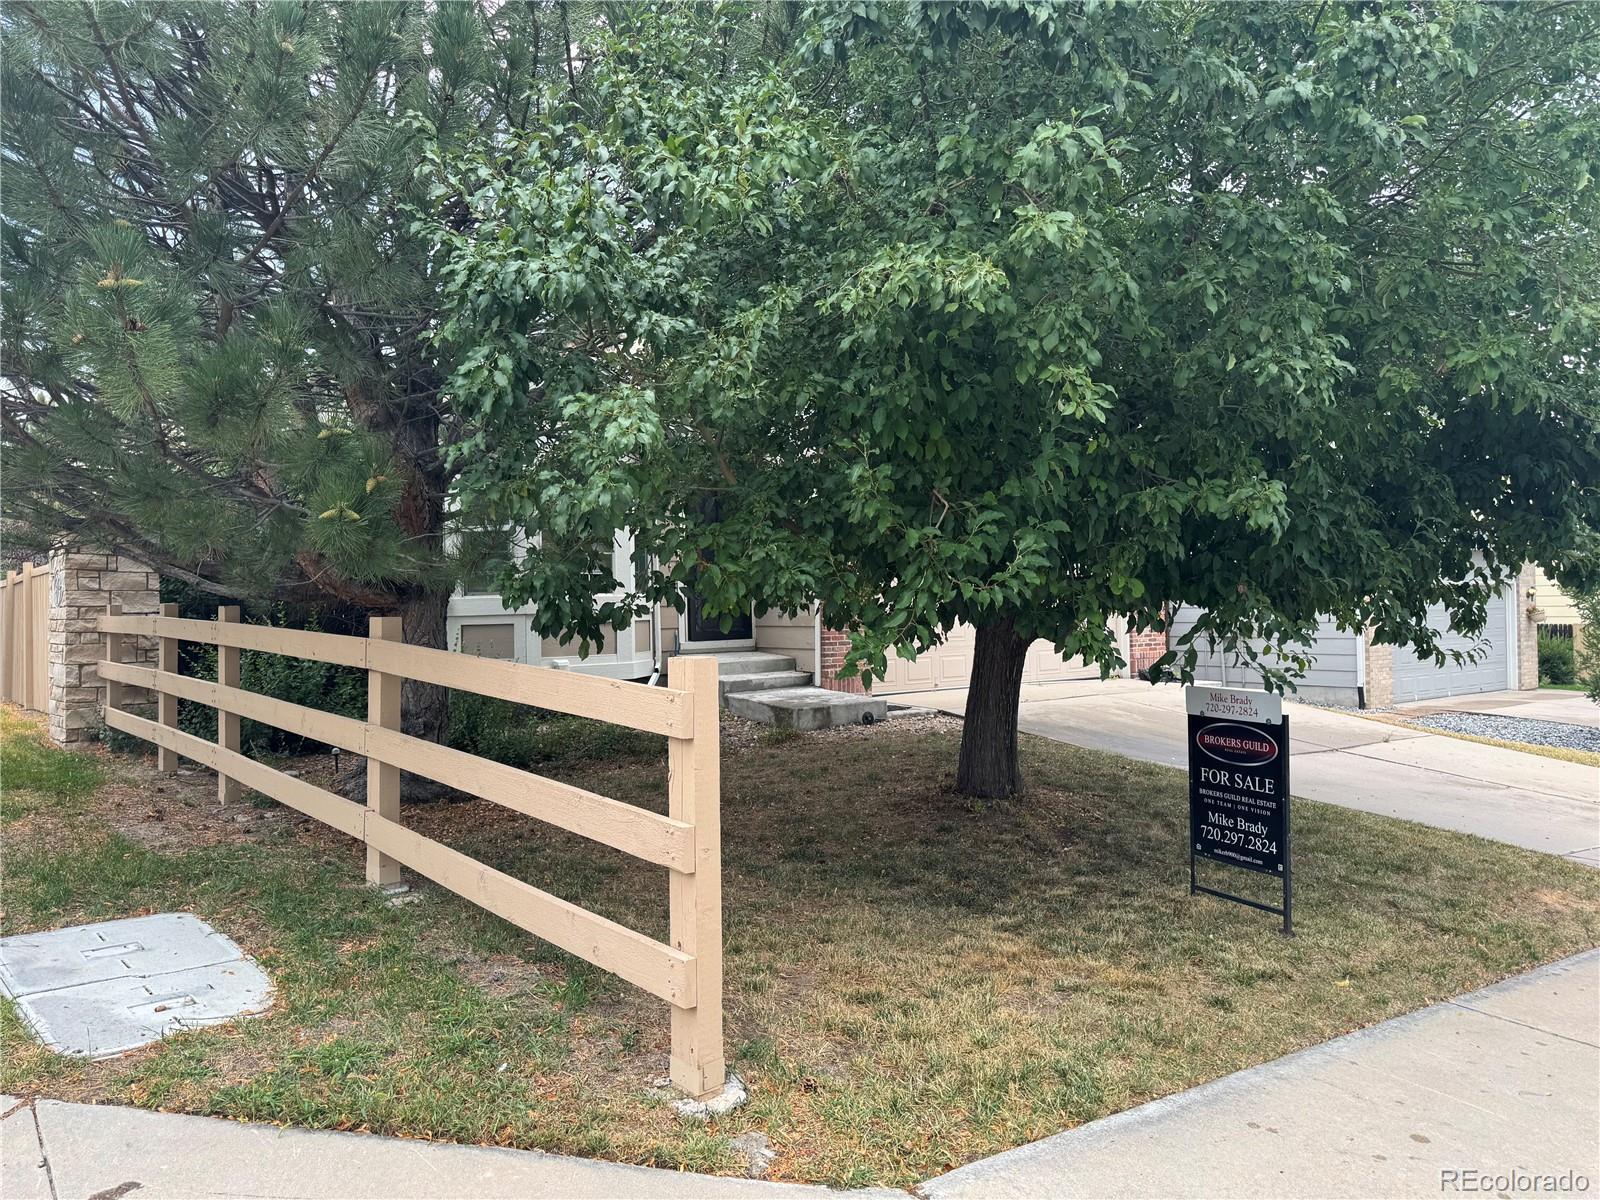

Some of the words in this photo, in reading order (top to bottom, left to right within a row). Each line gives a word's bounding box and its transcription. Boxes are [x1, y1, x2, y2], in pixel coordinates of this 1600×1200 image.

[1210, 692, 1228, 703] Mike
[1230, 694, 1253, 706] Brady
[1206, 702, 1259, 718] 720-297-2824
[1204, 734, 1241, 748] BROKERS
[1242, 740, 1270, 752] GUILD
[1200, 767, 1231, 787] FOR
[1234, 773, 1275, 795] SALE
[1199, 787, 1223, 798] BROKERS
[1223, 792, 1241, 802] GUILD
[1241, 796, 1257, 805] REAL
[1256, 799, 1277, 809] ESTATE
[1203, 797, 1215, 805] ONE
[1217, 800, 1232, 808] TEAM
[1237, 804, 1249, 812] ONE
[1250, 807, 1271, 816] VISION
[1208, 810, 1235, 828] Mike
[1237, 817, 1268, 838] Brady
[1200, 824, 1278, 855] 720.297.2824
